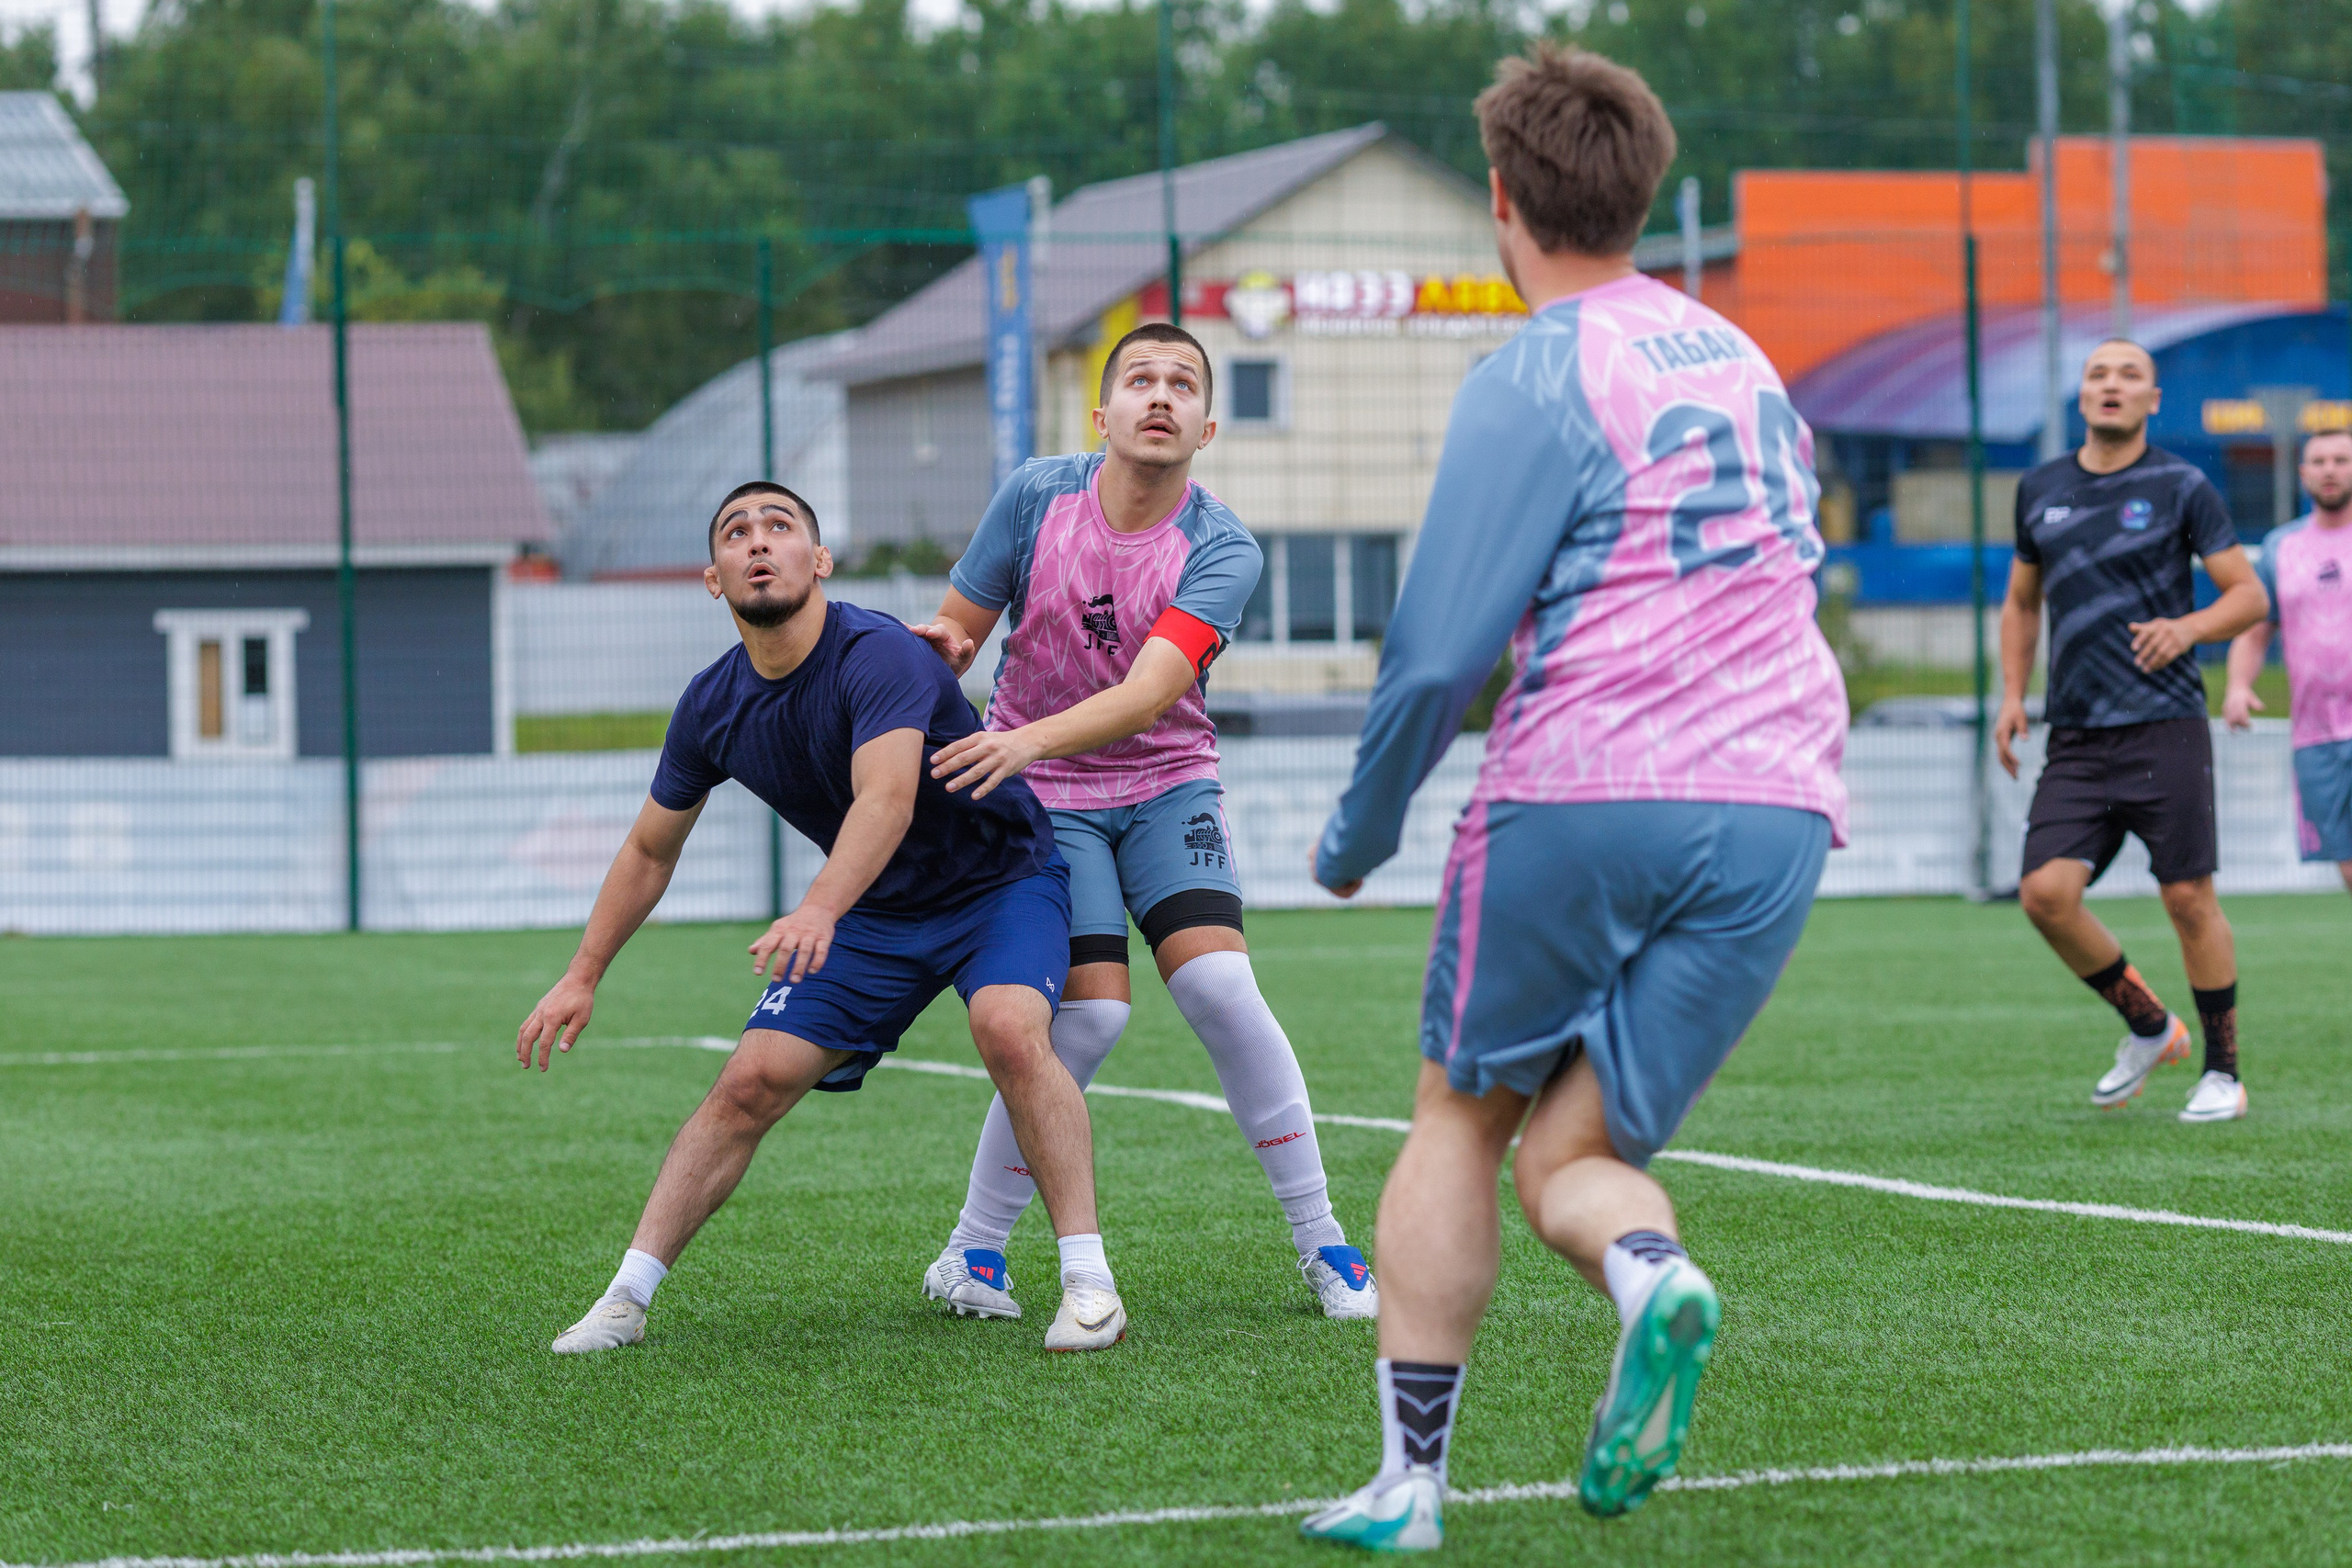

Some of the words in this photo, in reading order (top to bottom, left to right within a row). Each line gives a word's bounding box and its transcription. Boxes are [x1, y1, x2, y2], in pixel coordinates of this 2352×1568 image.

[1189, 851, 1227, 869] JFF
[749, 985, 793, 1019] 4
[1254, 1131, 1306, 1149] JÖGEL
